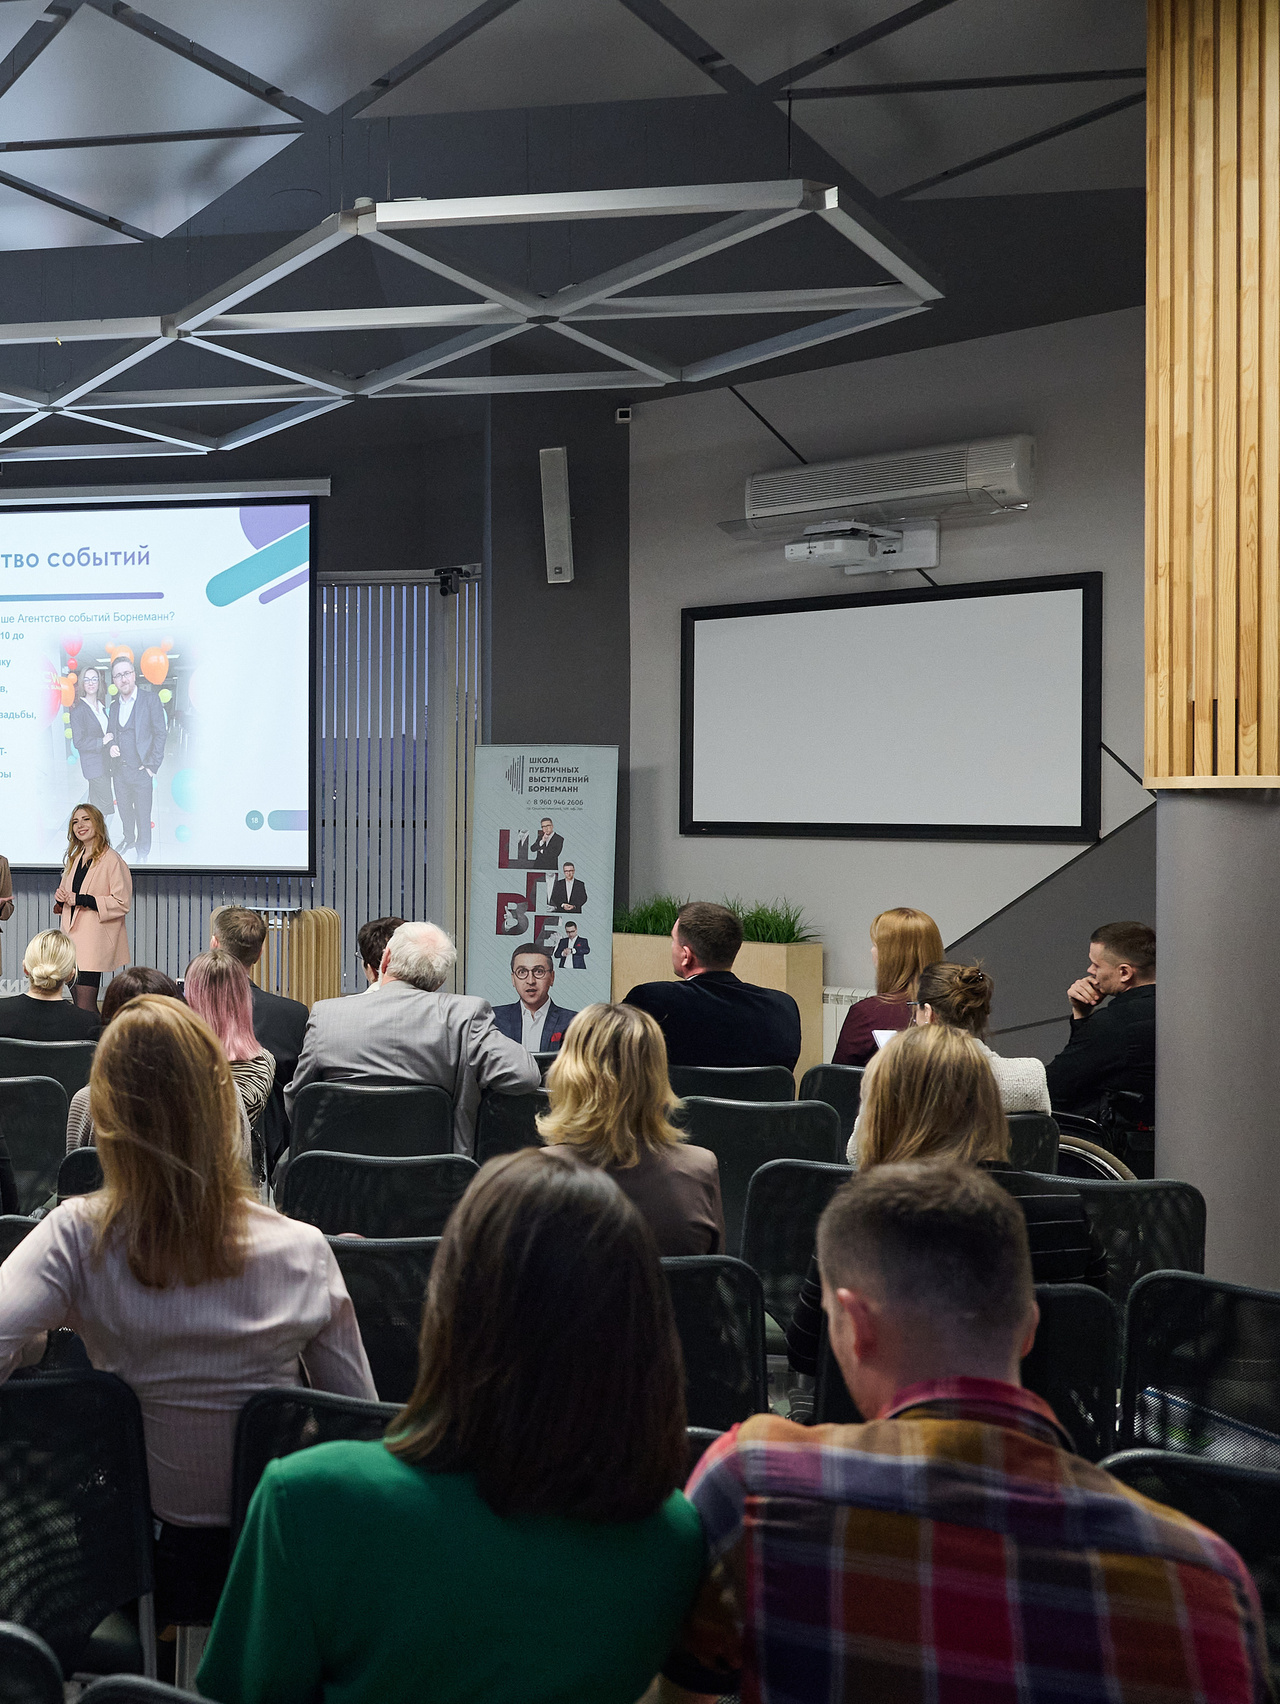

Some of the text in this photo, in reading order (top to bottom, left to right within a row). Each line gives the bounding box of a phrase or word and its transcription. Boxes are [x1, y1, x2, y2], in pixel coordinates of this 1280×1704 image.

[47, 545, 150, 567] событий
[17, 613, 66, 623] Агентство
[68, 612, 111, 622] событий
[113, 611, 175, 623] Борнеманн?
[0, 631, 10, 640] 10
[12, 632, 24, 641] до
[528, 775, 589, 783] ВЫСТУПЛЕНИЙ
